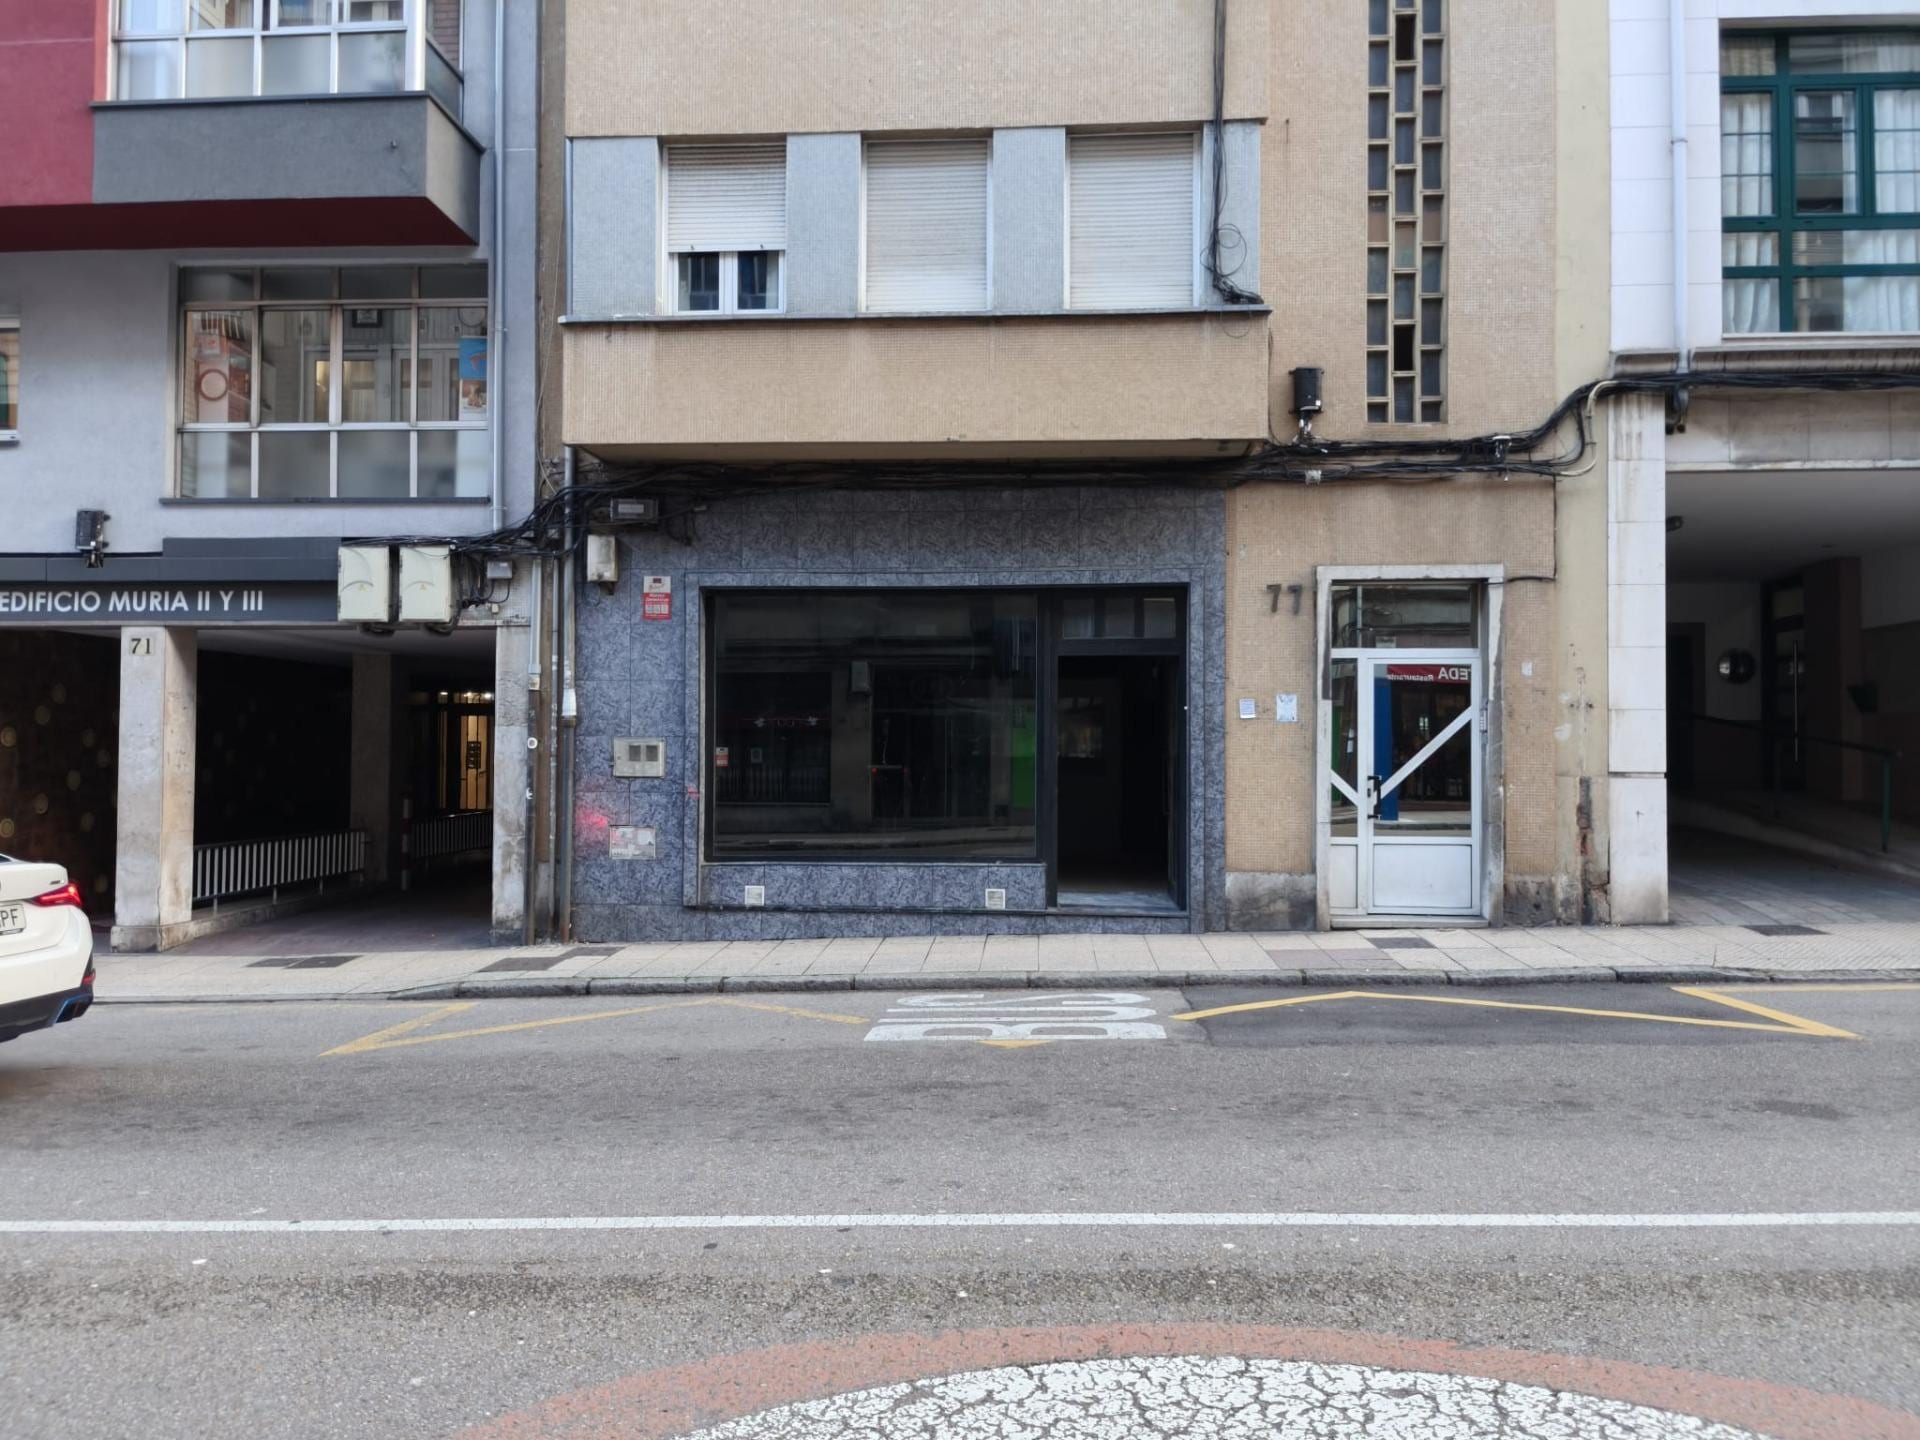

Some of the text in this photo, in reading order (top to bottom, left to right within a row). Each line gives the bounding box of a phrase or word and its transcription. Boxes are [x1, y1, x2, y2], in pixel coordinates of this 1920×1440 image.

[0, 590, 263, 612] EDIFICIO MURIA II Y III
[1266, 583, 1302, 615] 77
[130, 638, 152, 655] 71
[0, 908, 18, 927] PF
[864, 993, 1167, 1041] BUS
